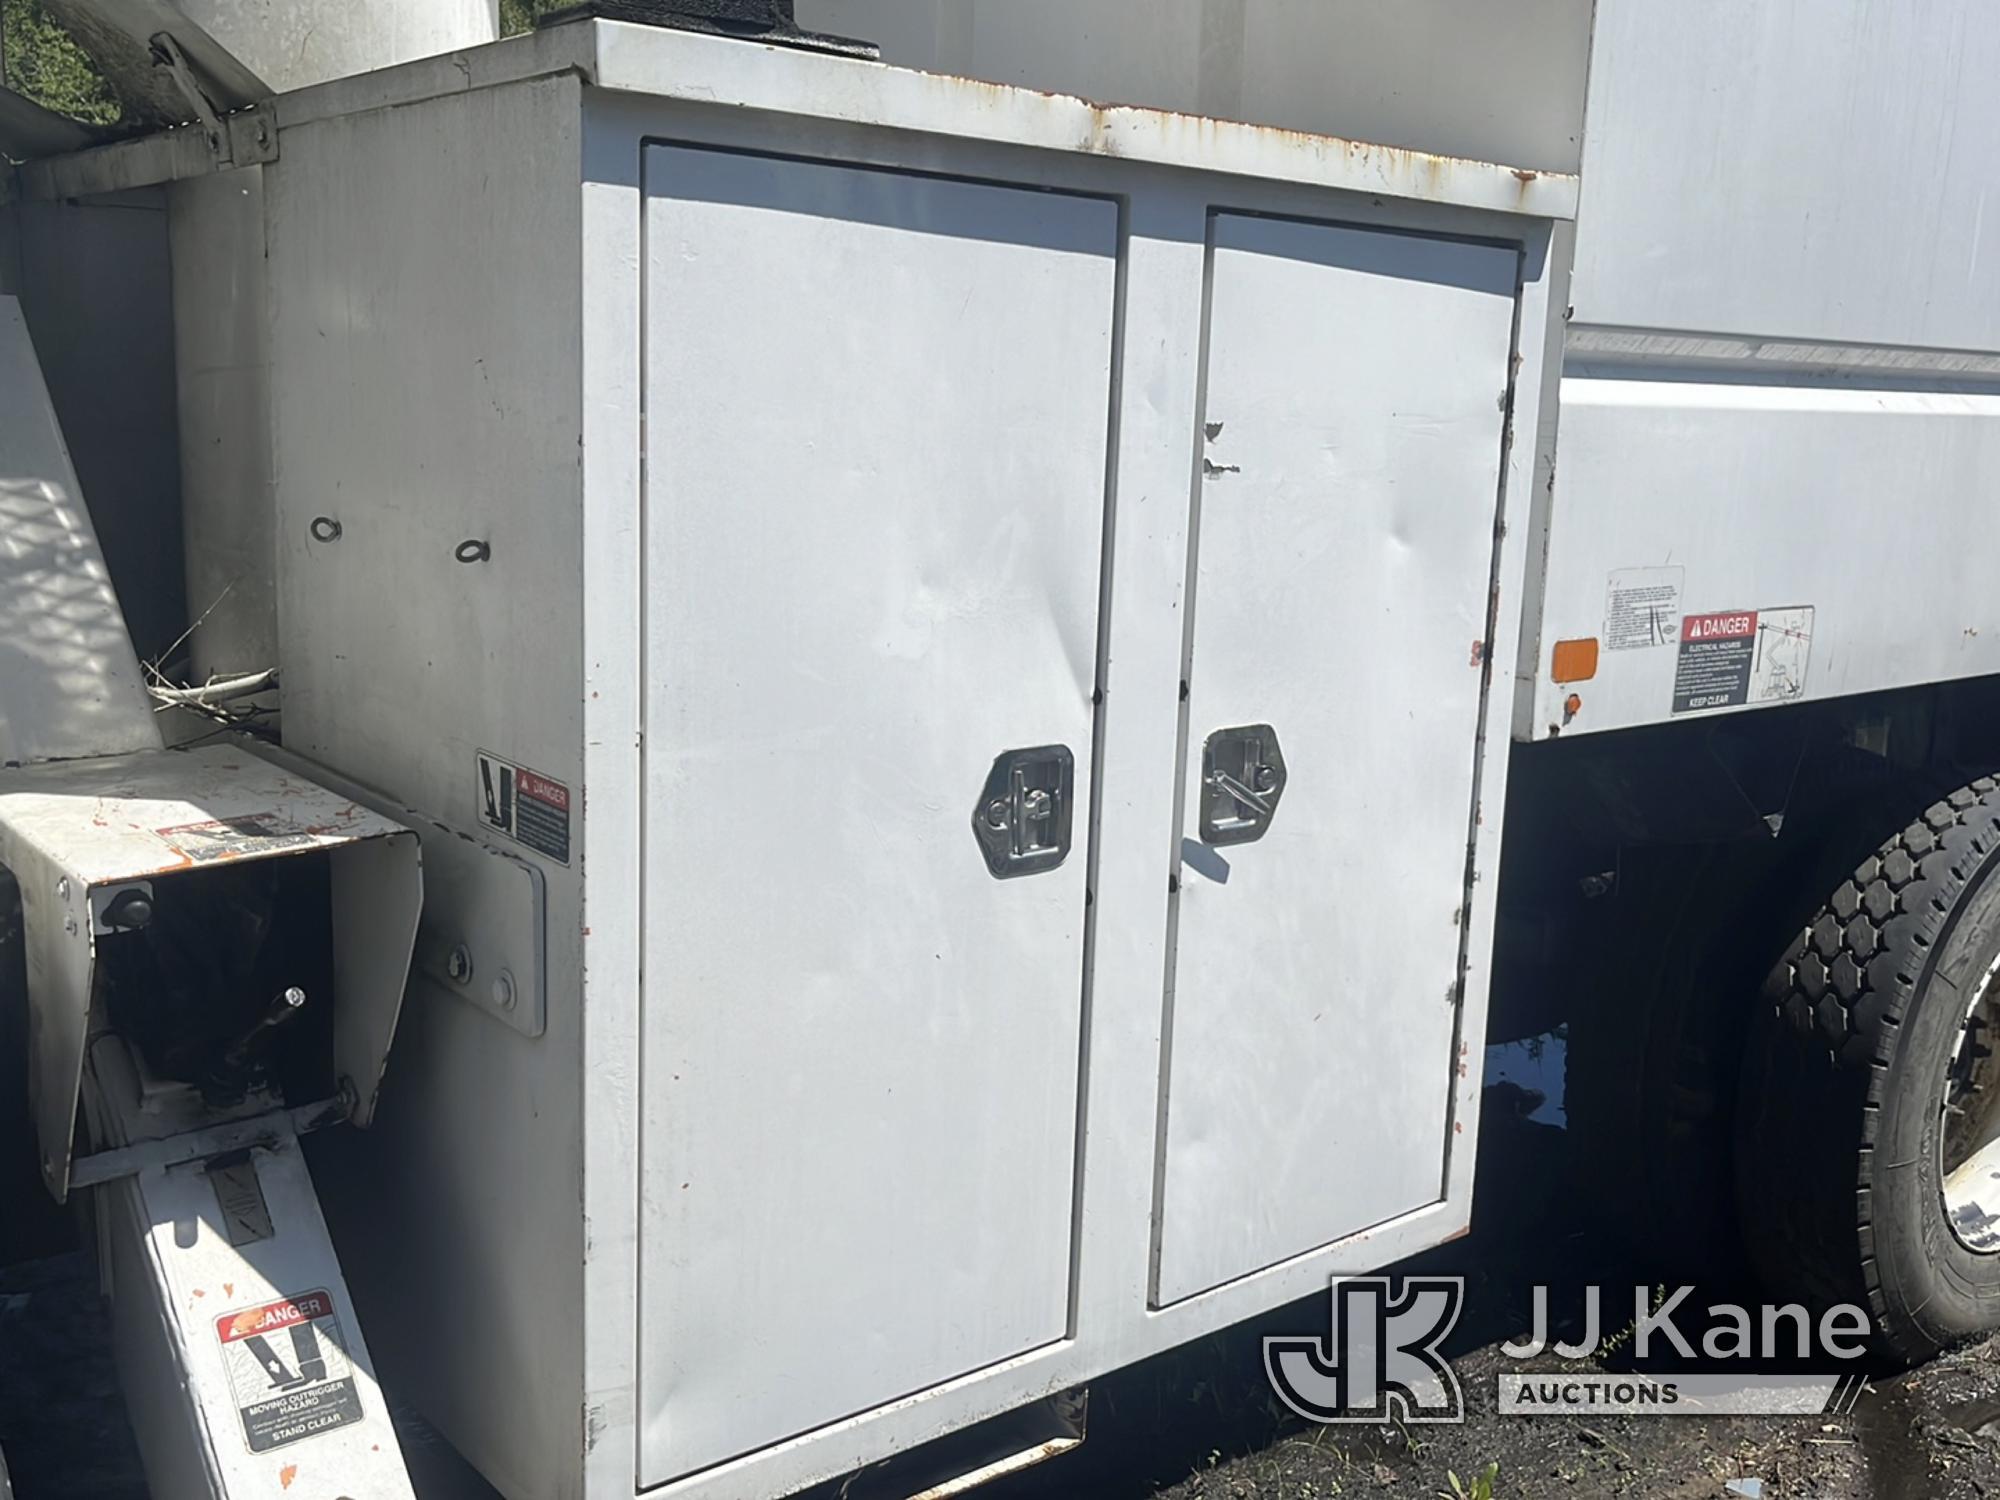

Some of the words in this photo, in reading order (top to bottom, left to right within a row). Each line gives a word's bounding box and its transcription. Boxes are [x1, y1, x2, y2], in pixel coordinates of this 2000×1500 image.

[1703, 617, 1749, 636] DANGER
[1689, 696, 1707, 707] KEEP
[1707, 694, 1729, 706] CLEAR
[532, 779, 566, 805] DANGER
[249, 1397, 288, 1416] MOVING
[288, 1381, 345, 1404] OUTRIGGER
[279, 1396, 319, 1415] HAZARD
[272, 1424, 306, 1441] STAND
[307, 1413, 342, 1431] CLEAR
